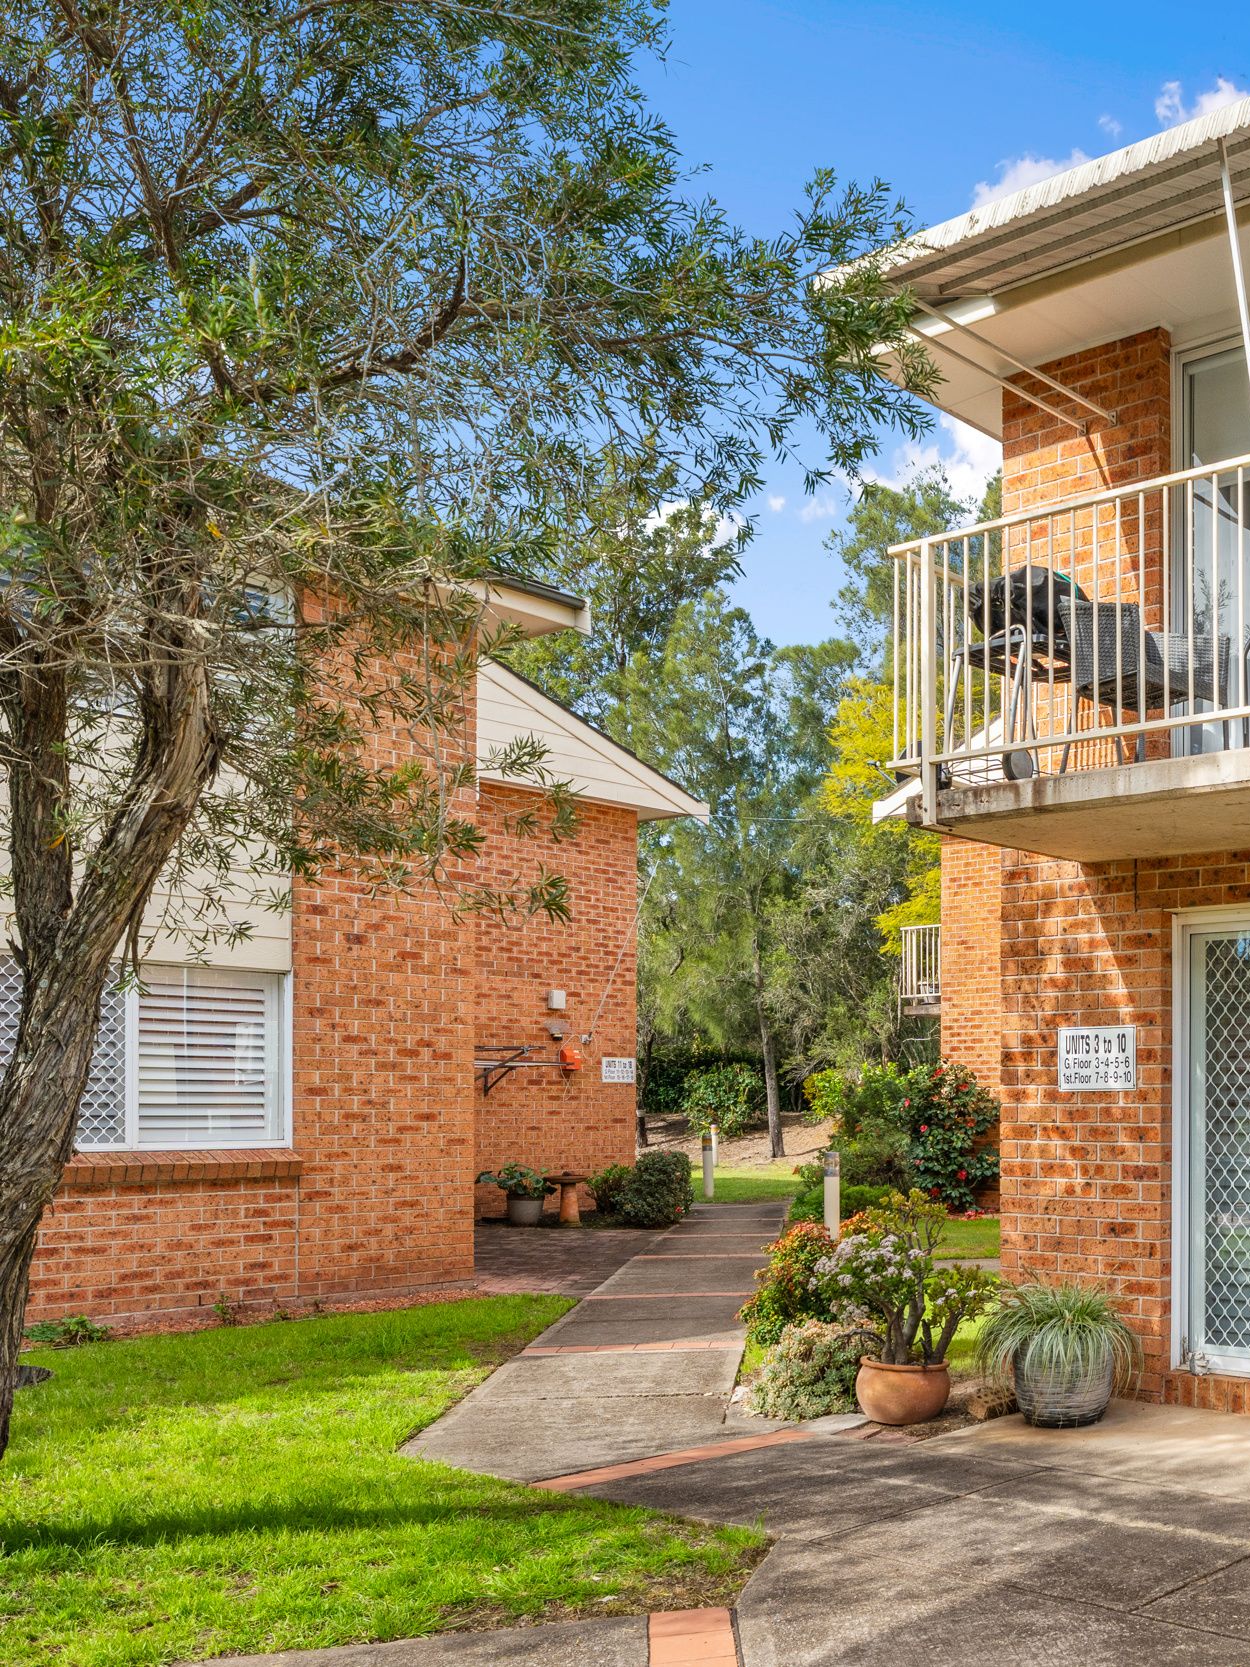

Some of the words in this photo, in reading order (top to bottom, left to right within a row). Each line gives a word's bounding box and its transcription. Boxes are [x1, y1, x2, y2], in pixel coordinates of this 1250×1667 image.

[1065, 1034, 1090, 1054] UNITS
[1094, 1034, 1099, 1054] 3
[1103, 1036, 1112, 1054] to
[1116, 1033, 1126, 1053] 10
[1073, 1057, 1092, 1069] Floor
[1094, 1056, 1130, 1069] 3-4-5-6
[1095, 1070, 1132, 1083] 7-8-9-10
